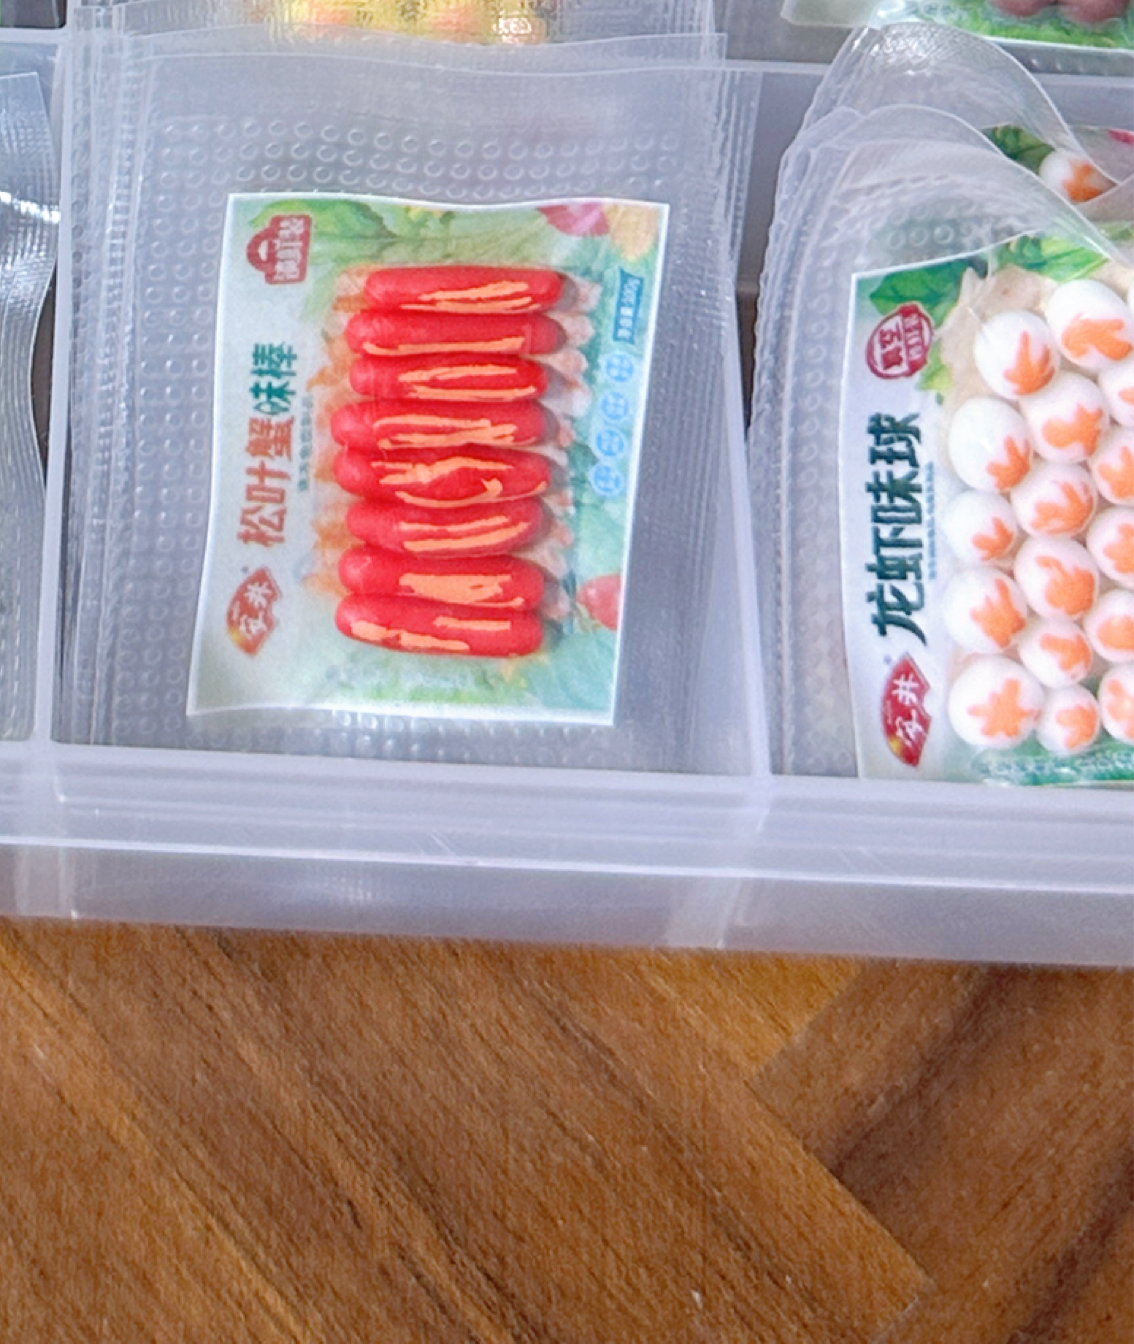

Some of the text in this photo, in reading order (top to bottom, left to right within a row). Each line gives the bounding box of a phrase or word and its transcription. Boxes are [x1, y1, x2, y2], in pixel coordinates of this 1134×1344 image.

[237, 341, 298, 549] 松叶蟹味棒
[866, 410, 928, 647] 龙虾味球
[894, 672, 921, 748] 安井
